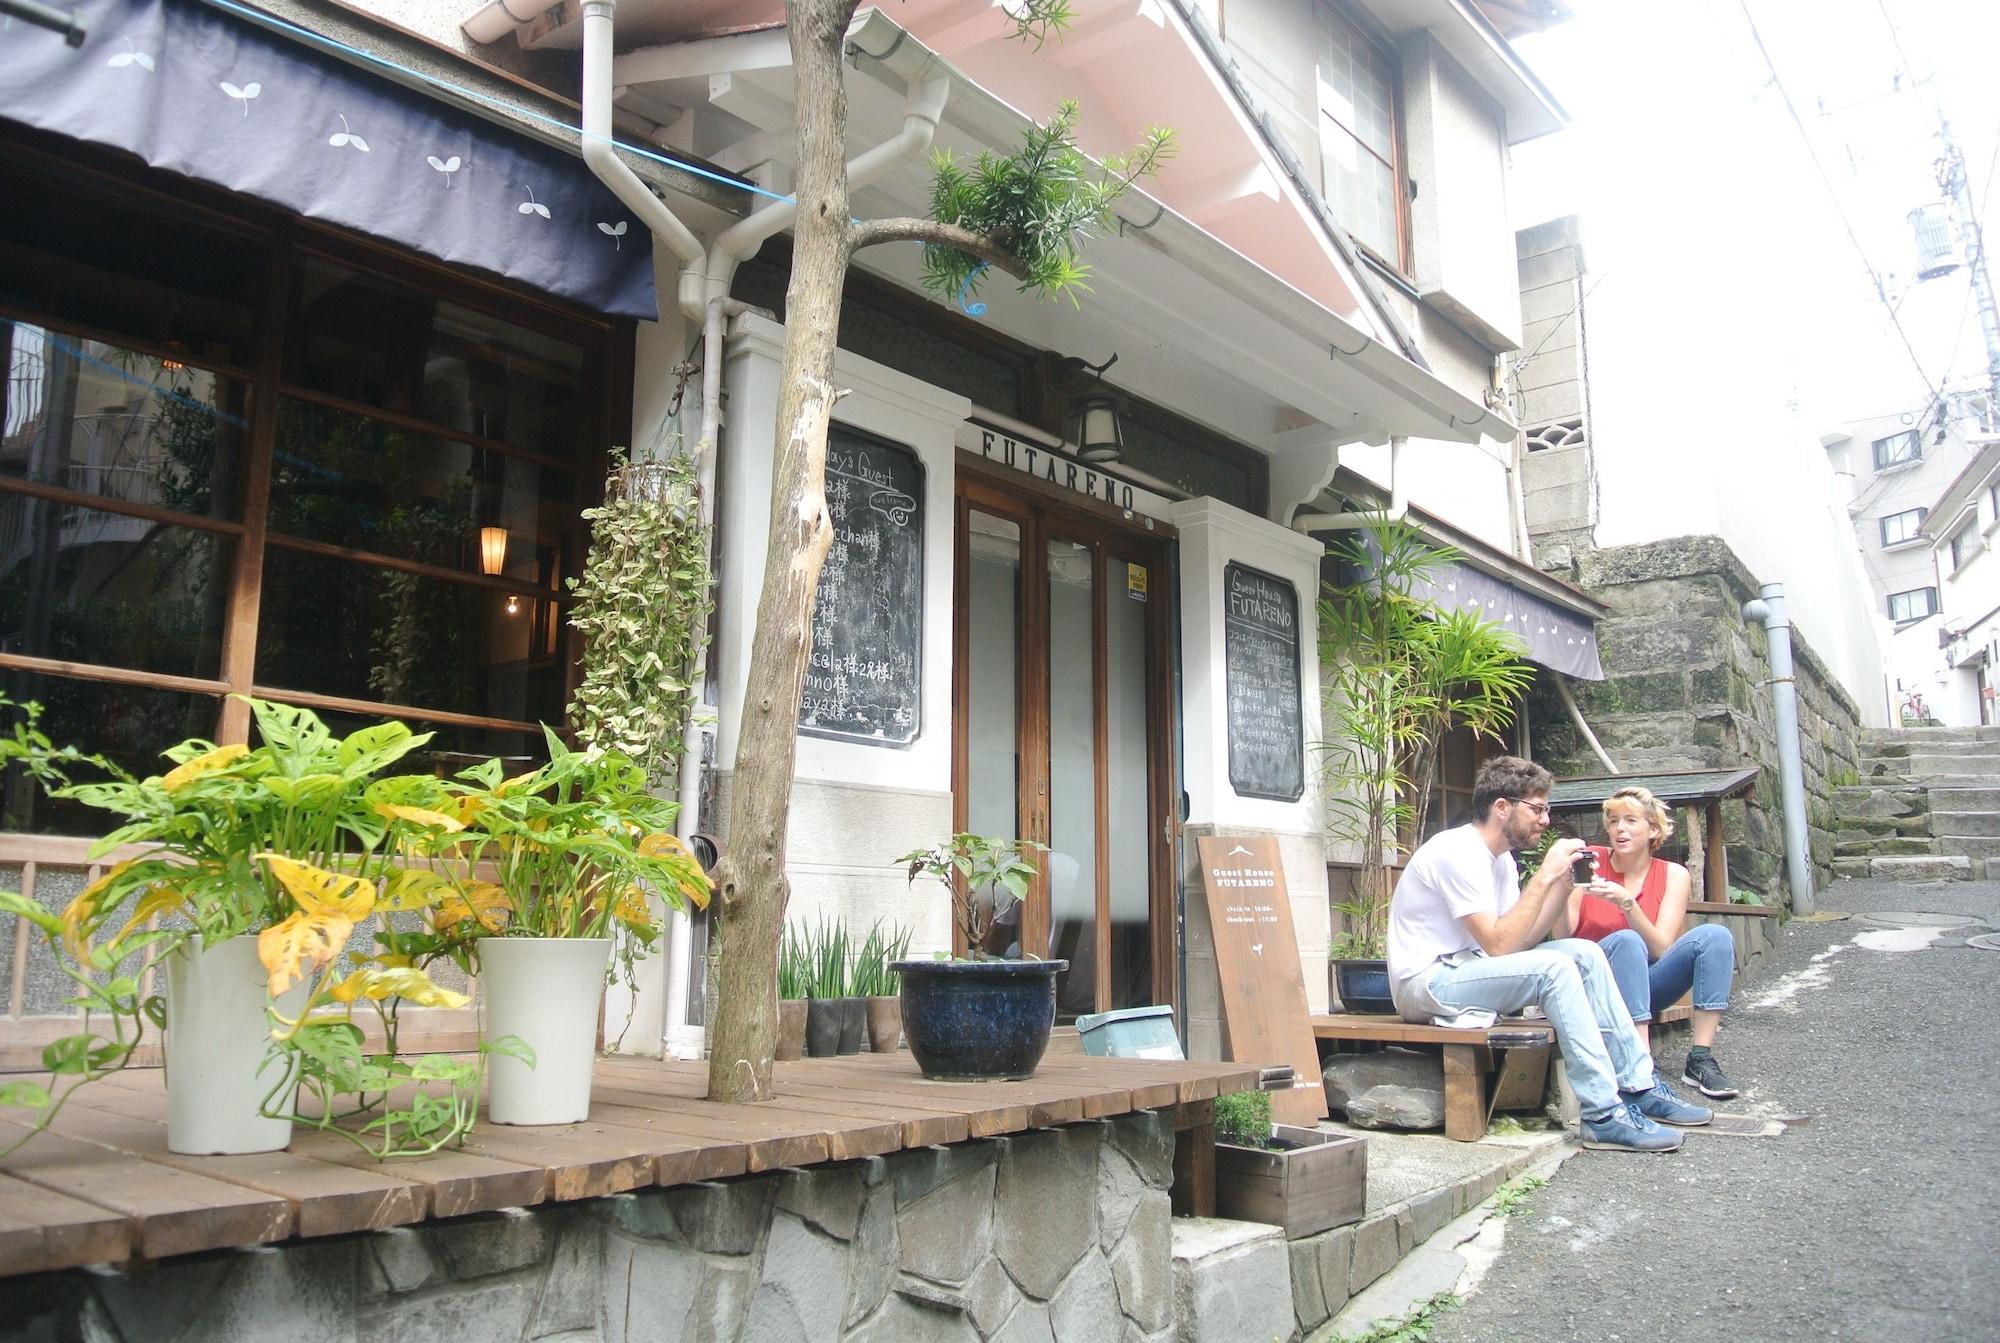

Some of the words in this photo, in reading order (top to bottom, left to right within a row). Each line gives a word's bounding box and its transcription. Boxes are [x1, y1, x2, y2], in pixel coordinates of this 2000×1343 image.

[858, 451, 894, 488] Guest
[982, 431, 1134, 510] FUTARENO
[833, 525, 882, 554] cchan様
[1230, 591, 1292, 628] FUTARENO
[1212, 868, 1242, 877] Guest
[1244, 868, 1275, 877] House
[1216, 879, 1275, 888] FUTARENO
